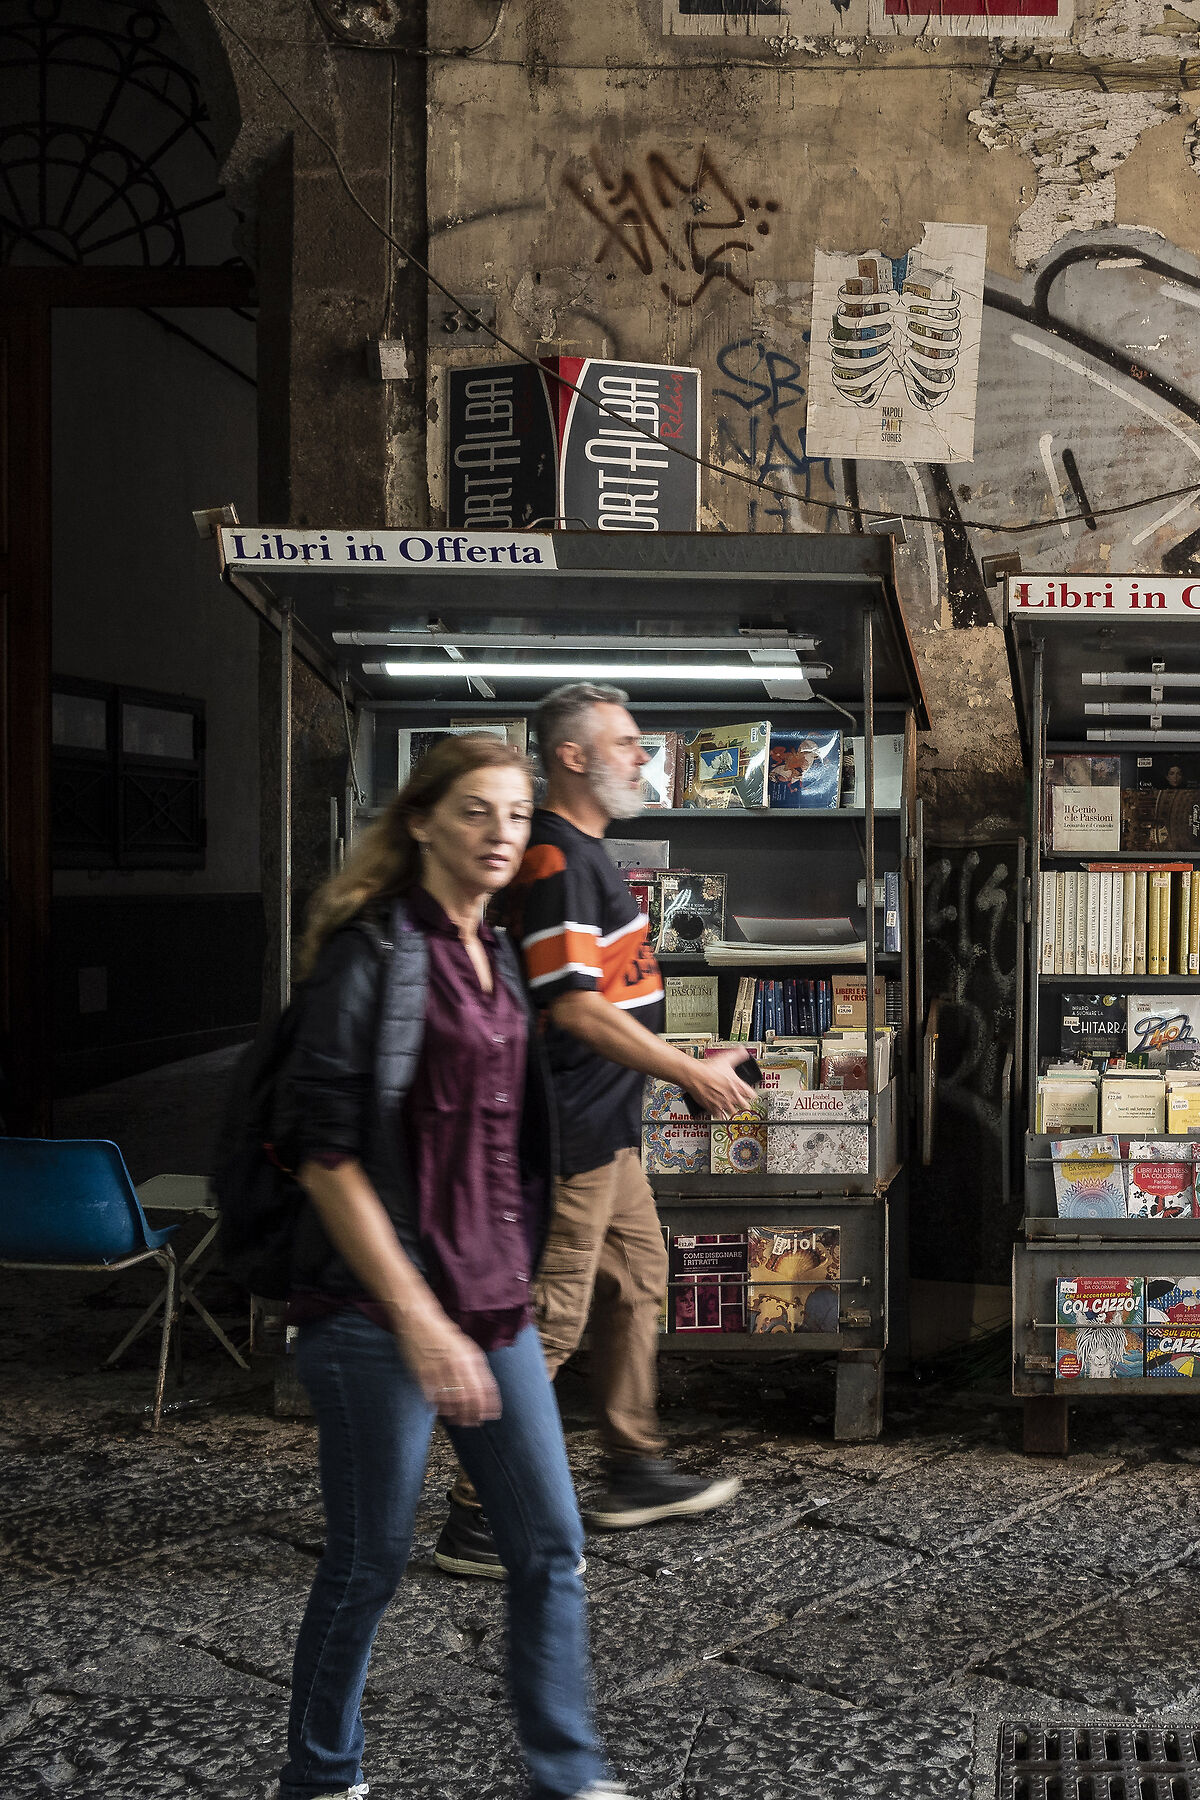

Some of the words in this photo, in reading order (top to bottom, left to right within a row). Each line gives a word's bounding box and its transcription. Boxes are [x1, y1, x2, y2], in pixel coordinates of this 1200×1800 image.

[882, 407, 903, 417] NAPOLI
[881, 433, 902, 442] STORIES
[230, 534, 333, 561] Libri
[346, 535, 386, 561] in
[400, 537, 543, 564] Offerta
[1016, 583, 1114, 608] Libri
[1129, 583, 1167, 609] in
[1064, 805, 1070, 813] Il
[1072, 805, 1096, 813] Genio
[671, 988, 713, 997] PASOLINI
[1070, 1021, 1127, 1034] CHITARRA
[759, 1081, 779, 1089] fiori
[794, 1097, 844, 1110] Allende
[664, 1130, 681, 1138] dei
[774, 1233, 816, 1254] ujol
[705, 1251, 743, 1259] DISEGNARE
[1063, 1299, 1090, 1315] COL
[1092, 1296, 1141, 1313] CAZZO!
